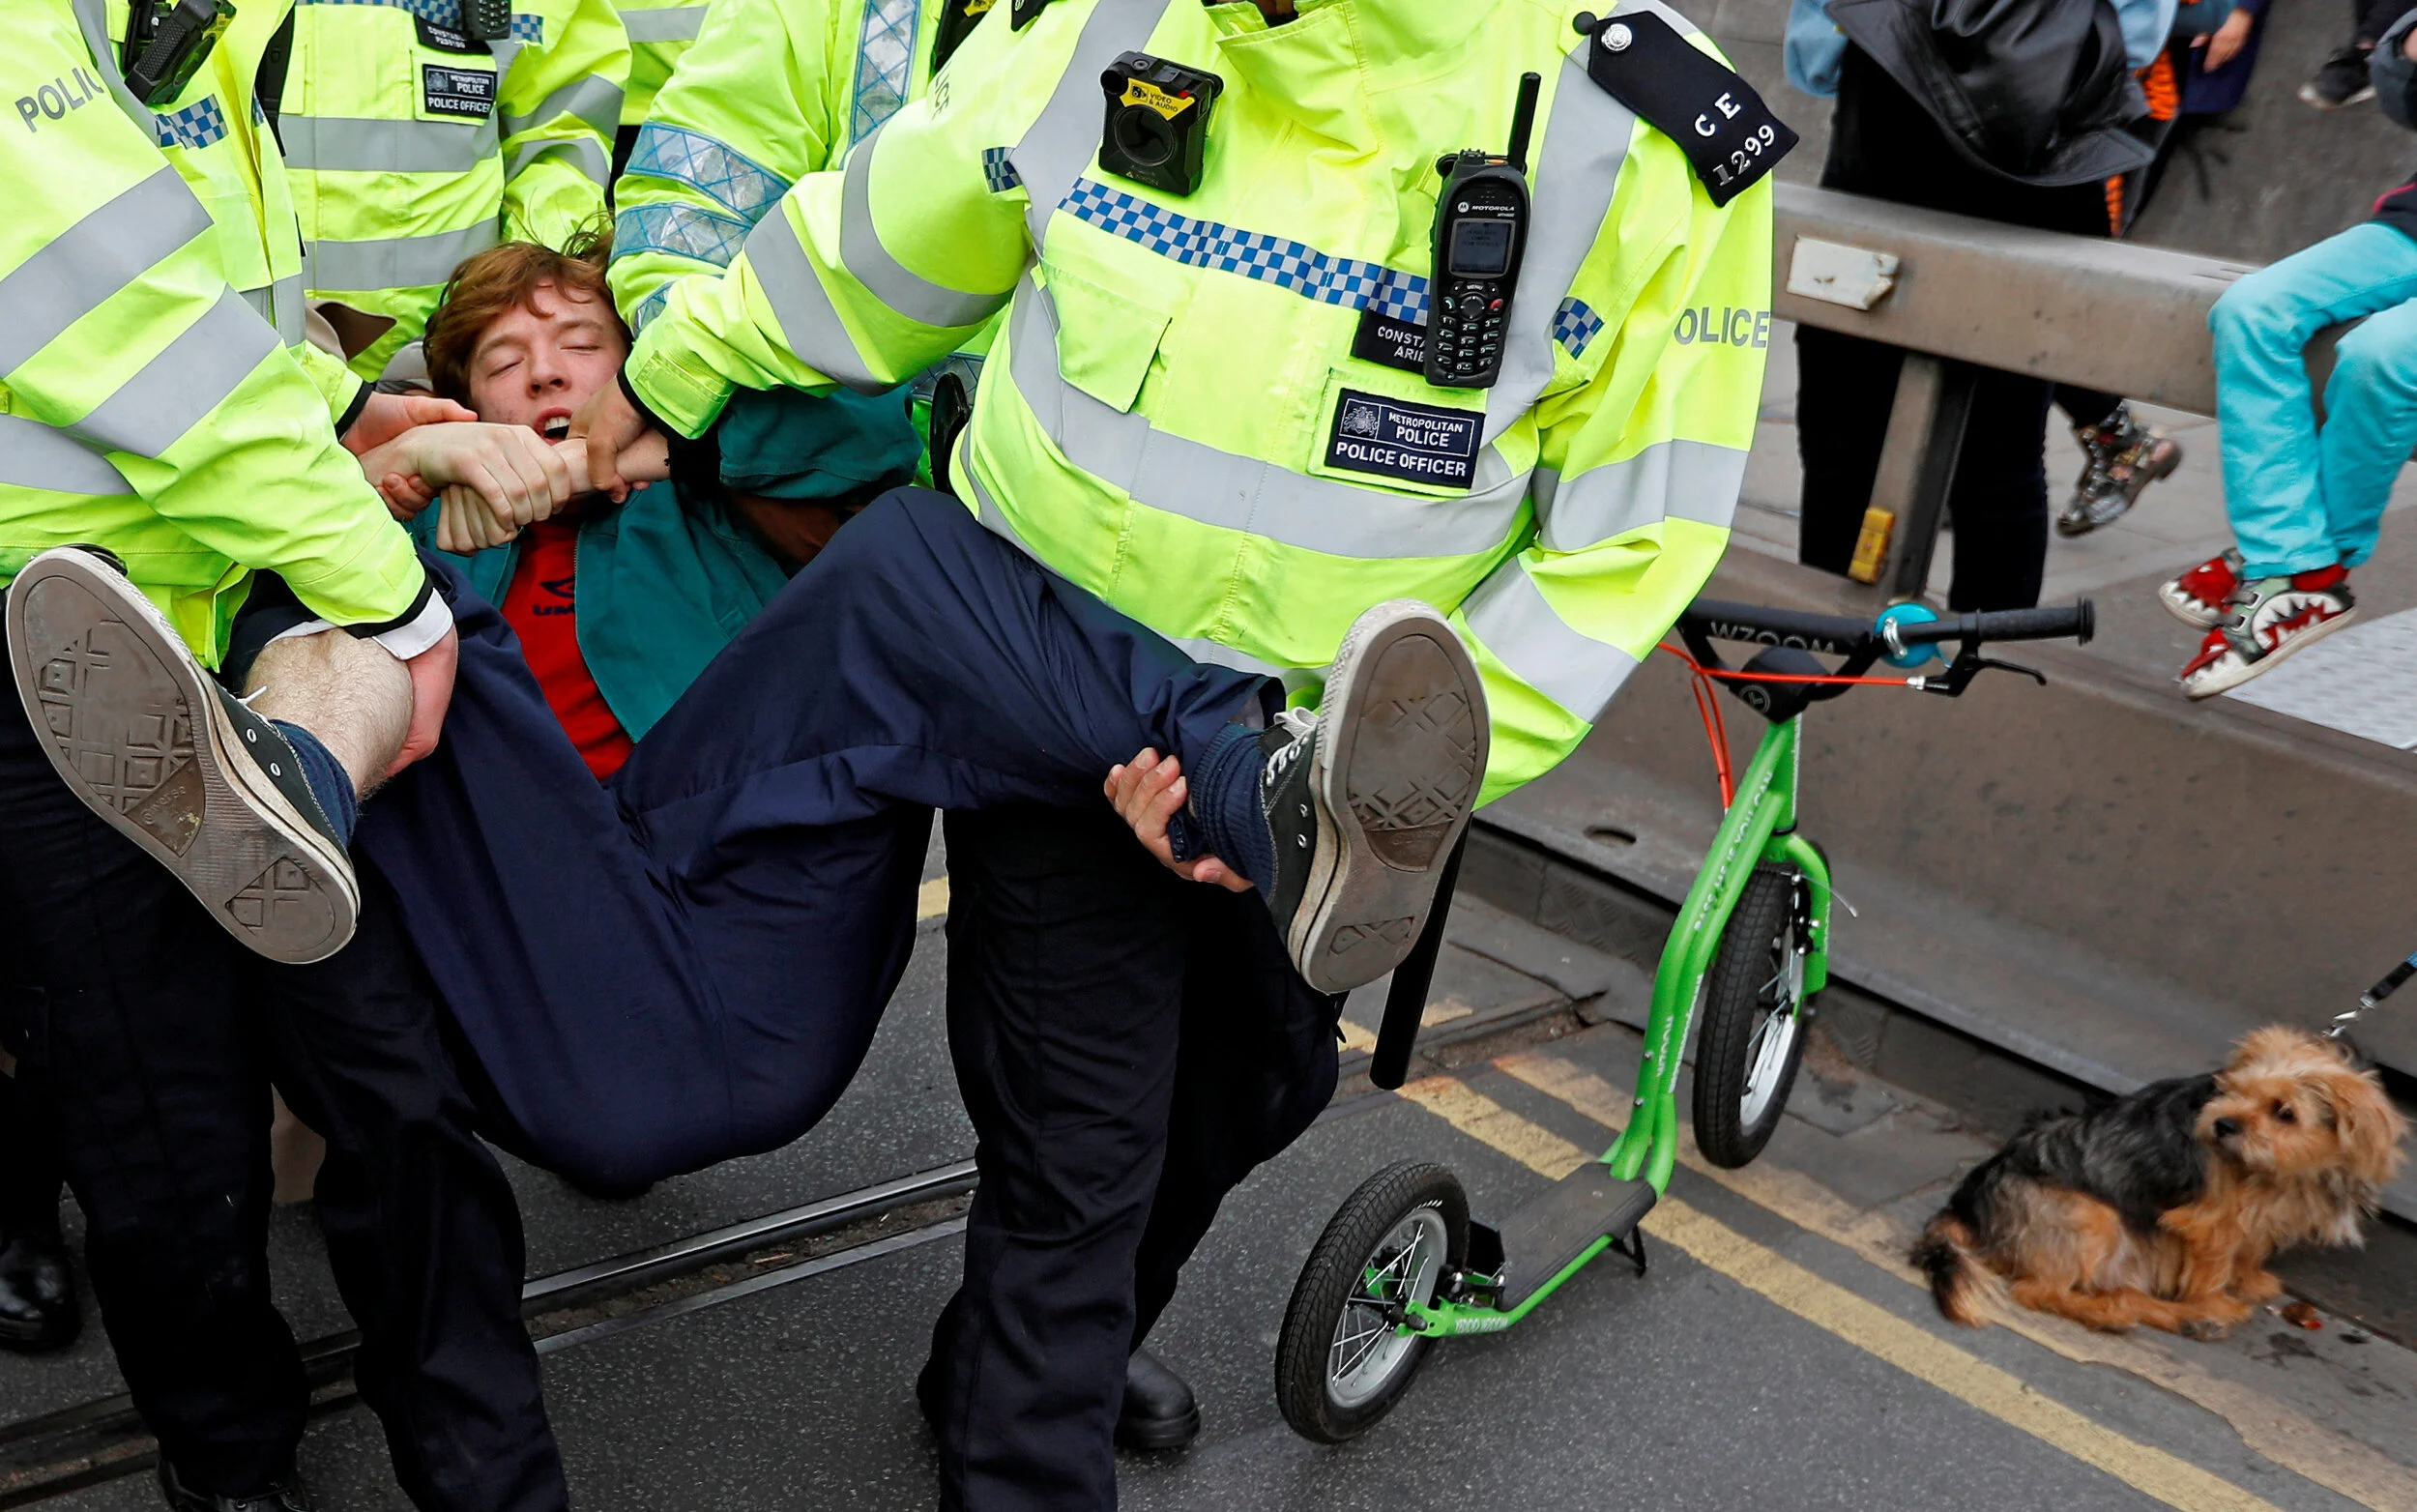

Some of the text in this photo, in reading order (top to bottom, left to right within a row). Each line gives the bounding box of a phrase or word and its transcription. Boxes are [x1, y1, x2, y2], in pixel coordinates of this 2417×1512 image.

[450, 74, 489, 85] METROPOLITAN
[456, 82, 485, 95] POLICE
[428, 97, 459, 110] POLICE
[1150, 92, 1172, 103] VIDEO
[1155, 101, 1179, 113] AUDIO
[1712, 125, 1775, 187] 1299
[1674, 306, 1770, 348] OLICE
[1388, 412, 1464, 433] METROPOLITAN
[1396, 425, 1450, 448] POLICE
[1335, 442, 1467, 477] POLICE OFFICER
[1710, 621, 1835, 654] WZOOM
